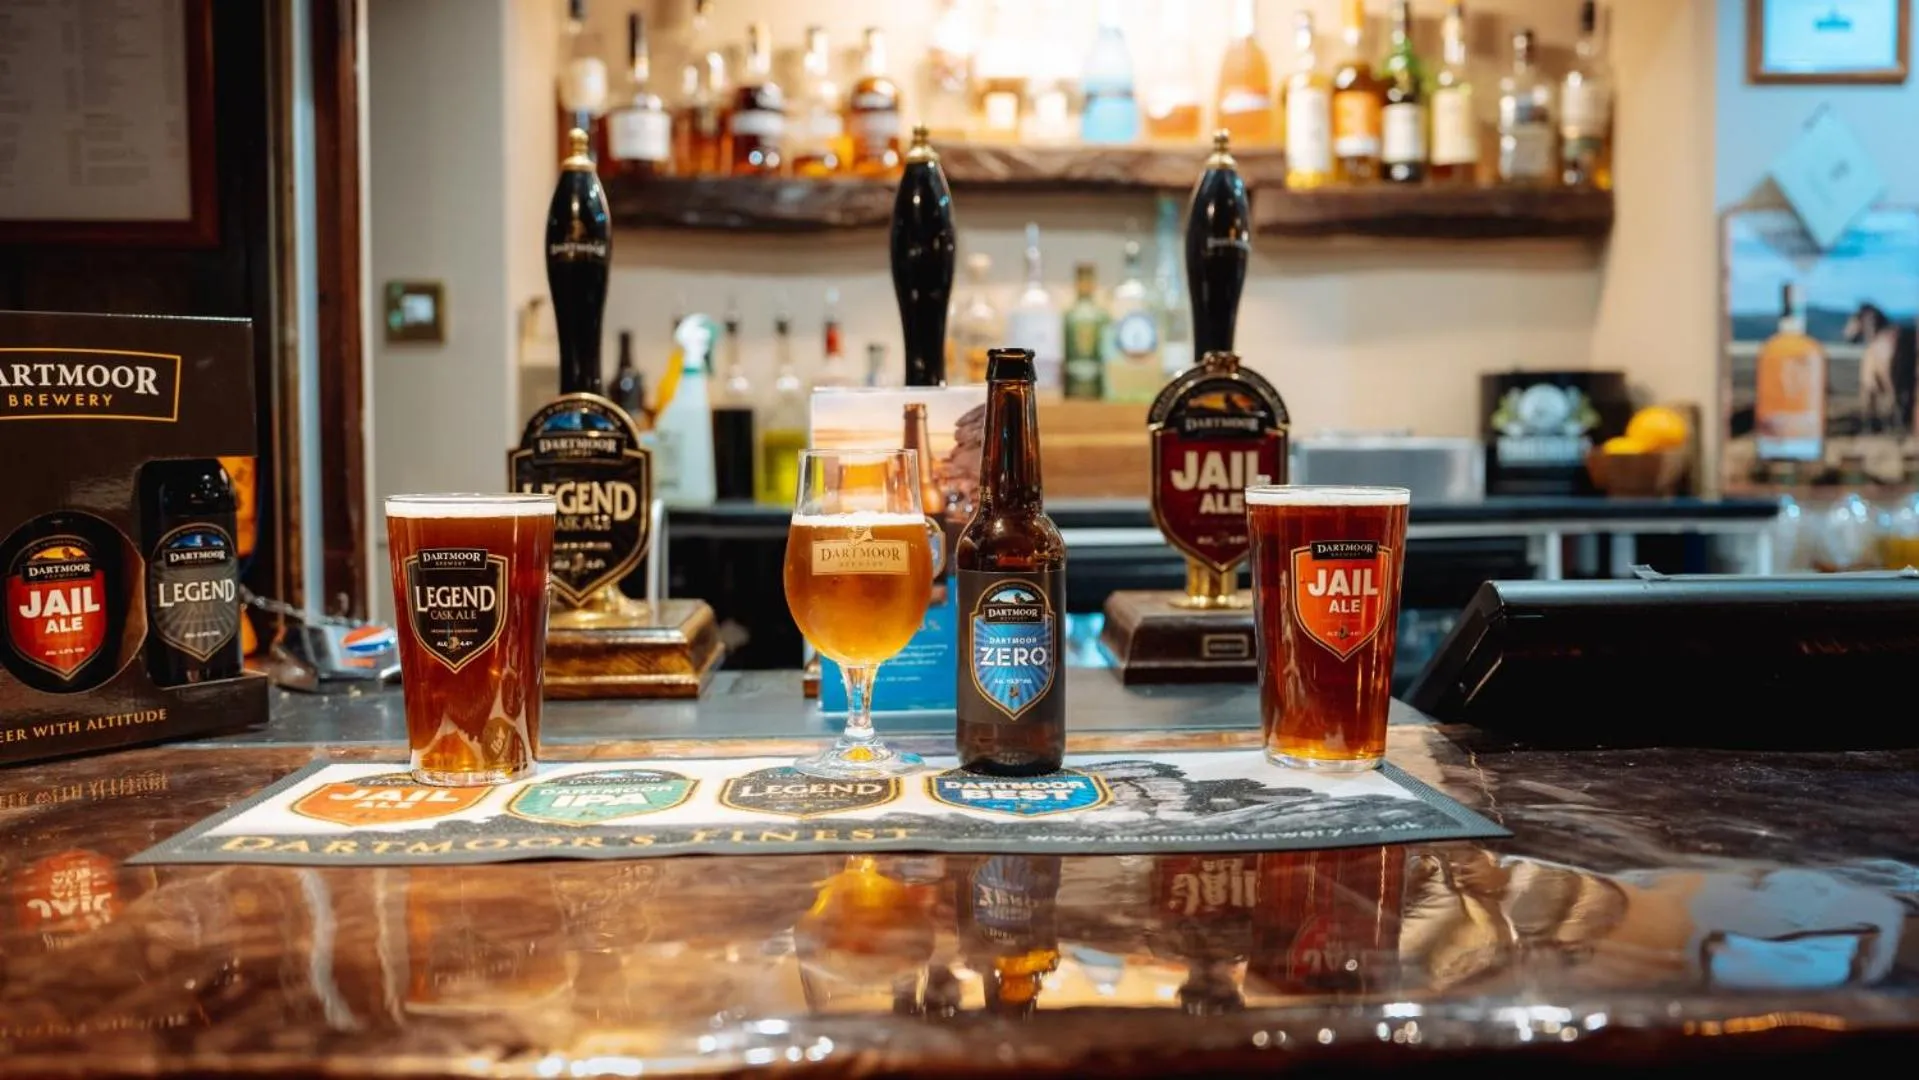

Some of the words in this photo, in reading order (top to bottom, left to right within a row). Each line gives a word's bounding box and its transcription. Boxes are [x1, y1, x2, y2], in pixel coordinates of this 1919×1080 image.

[8, 393, 113, 408] BREWERY
[539, 438, 617, 453] DARTMOOR
[1170, 450, 1272, 491] JAIL
[523, 480, 637, 521] GEND
[1199, 492, 1246, 515] ALE
[820, 547, 901, 562] DARTMOOR
[1317, 543, 1374, 554] DARTMOOR
[169, 550, 226, 563] DARTMOOR
[422, 552, 481, 562] DARTMOOR
[28, 563, 91, 578] DARTMOOR
[1307, 568, 1379, 597] JAIL
[158, 579, 236, 608] LEGEND
[415, 585, 497, 612] LEGEND
[19, 586, 101, 618] JAIL
[1328, 599, 1361, 613] ALE
[430, 610, 454, 620] CASK
[456, 610, 477, 620] ALE
[988, 608, 1039, 618] DARTMOOR
[45, 616, 84, 634] ALE
[989, 636, 1037, 644] DARTMOOR
[980, 646, 1047, 666] ZERO
[32, 720, 81, 738] WITH
[86, 708, 168, 731] ALTITUDE
[538, 785, 674, 796] DARTMOOR
[740, 783, 884, 797] LEGEND
[944, 780, 1089, 789] DARTMOOR
[327, 789, 461, 802] JAIL
[551, 793, 651, 808] IPA
[961, 789, 1075, 800] BEST
[352, 801, 417, 809] ALE
[220, 833, 656, 855] DARTMOOR'S
[690, 827, 916, 844] FINEST
